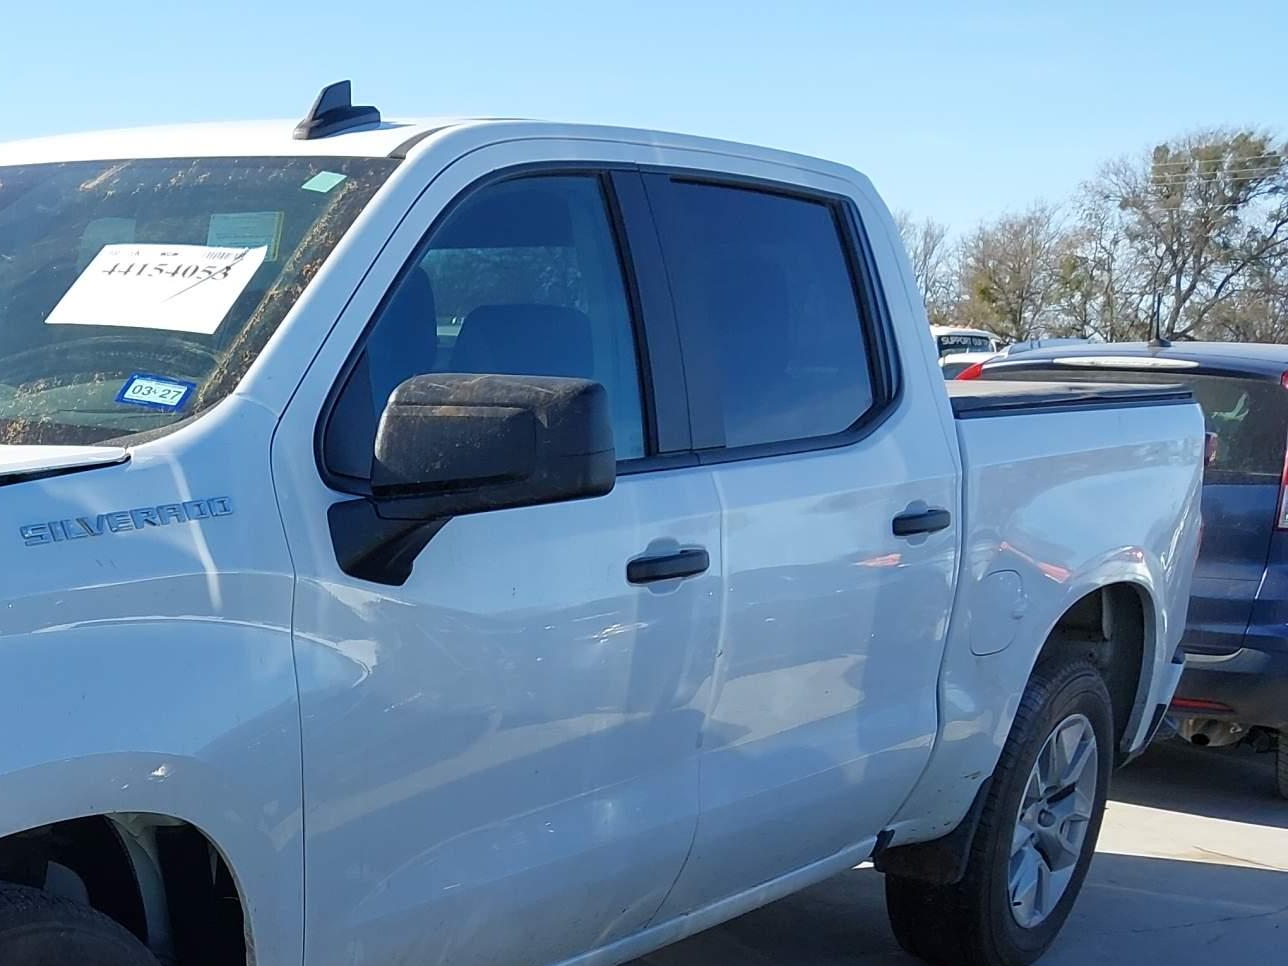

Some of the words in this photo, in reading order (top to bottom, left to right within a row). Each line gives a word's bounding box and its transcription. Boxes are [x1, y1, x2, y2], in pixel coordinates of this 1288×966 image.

[101, 261, 232, 281] 44154053
[132, 384, 153, 396] 03
[158, 388, 182, 400] 27
[19, 496, 233, 547] SILVERADO
